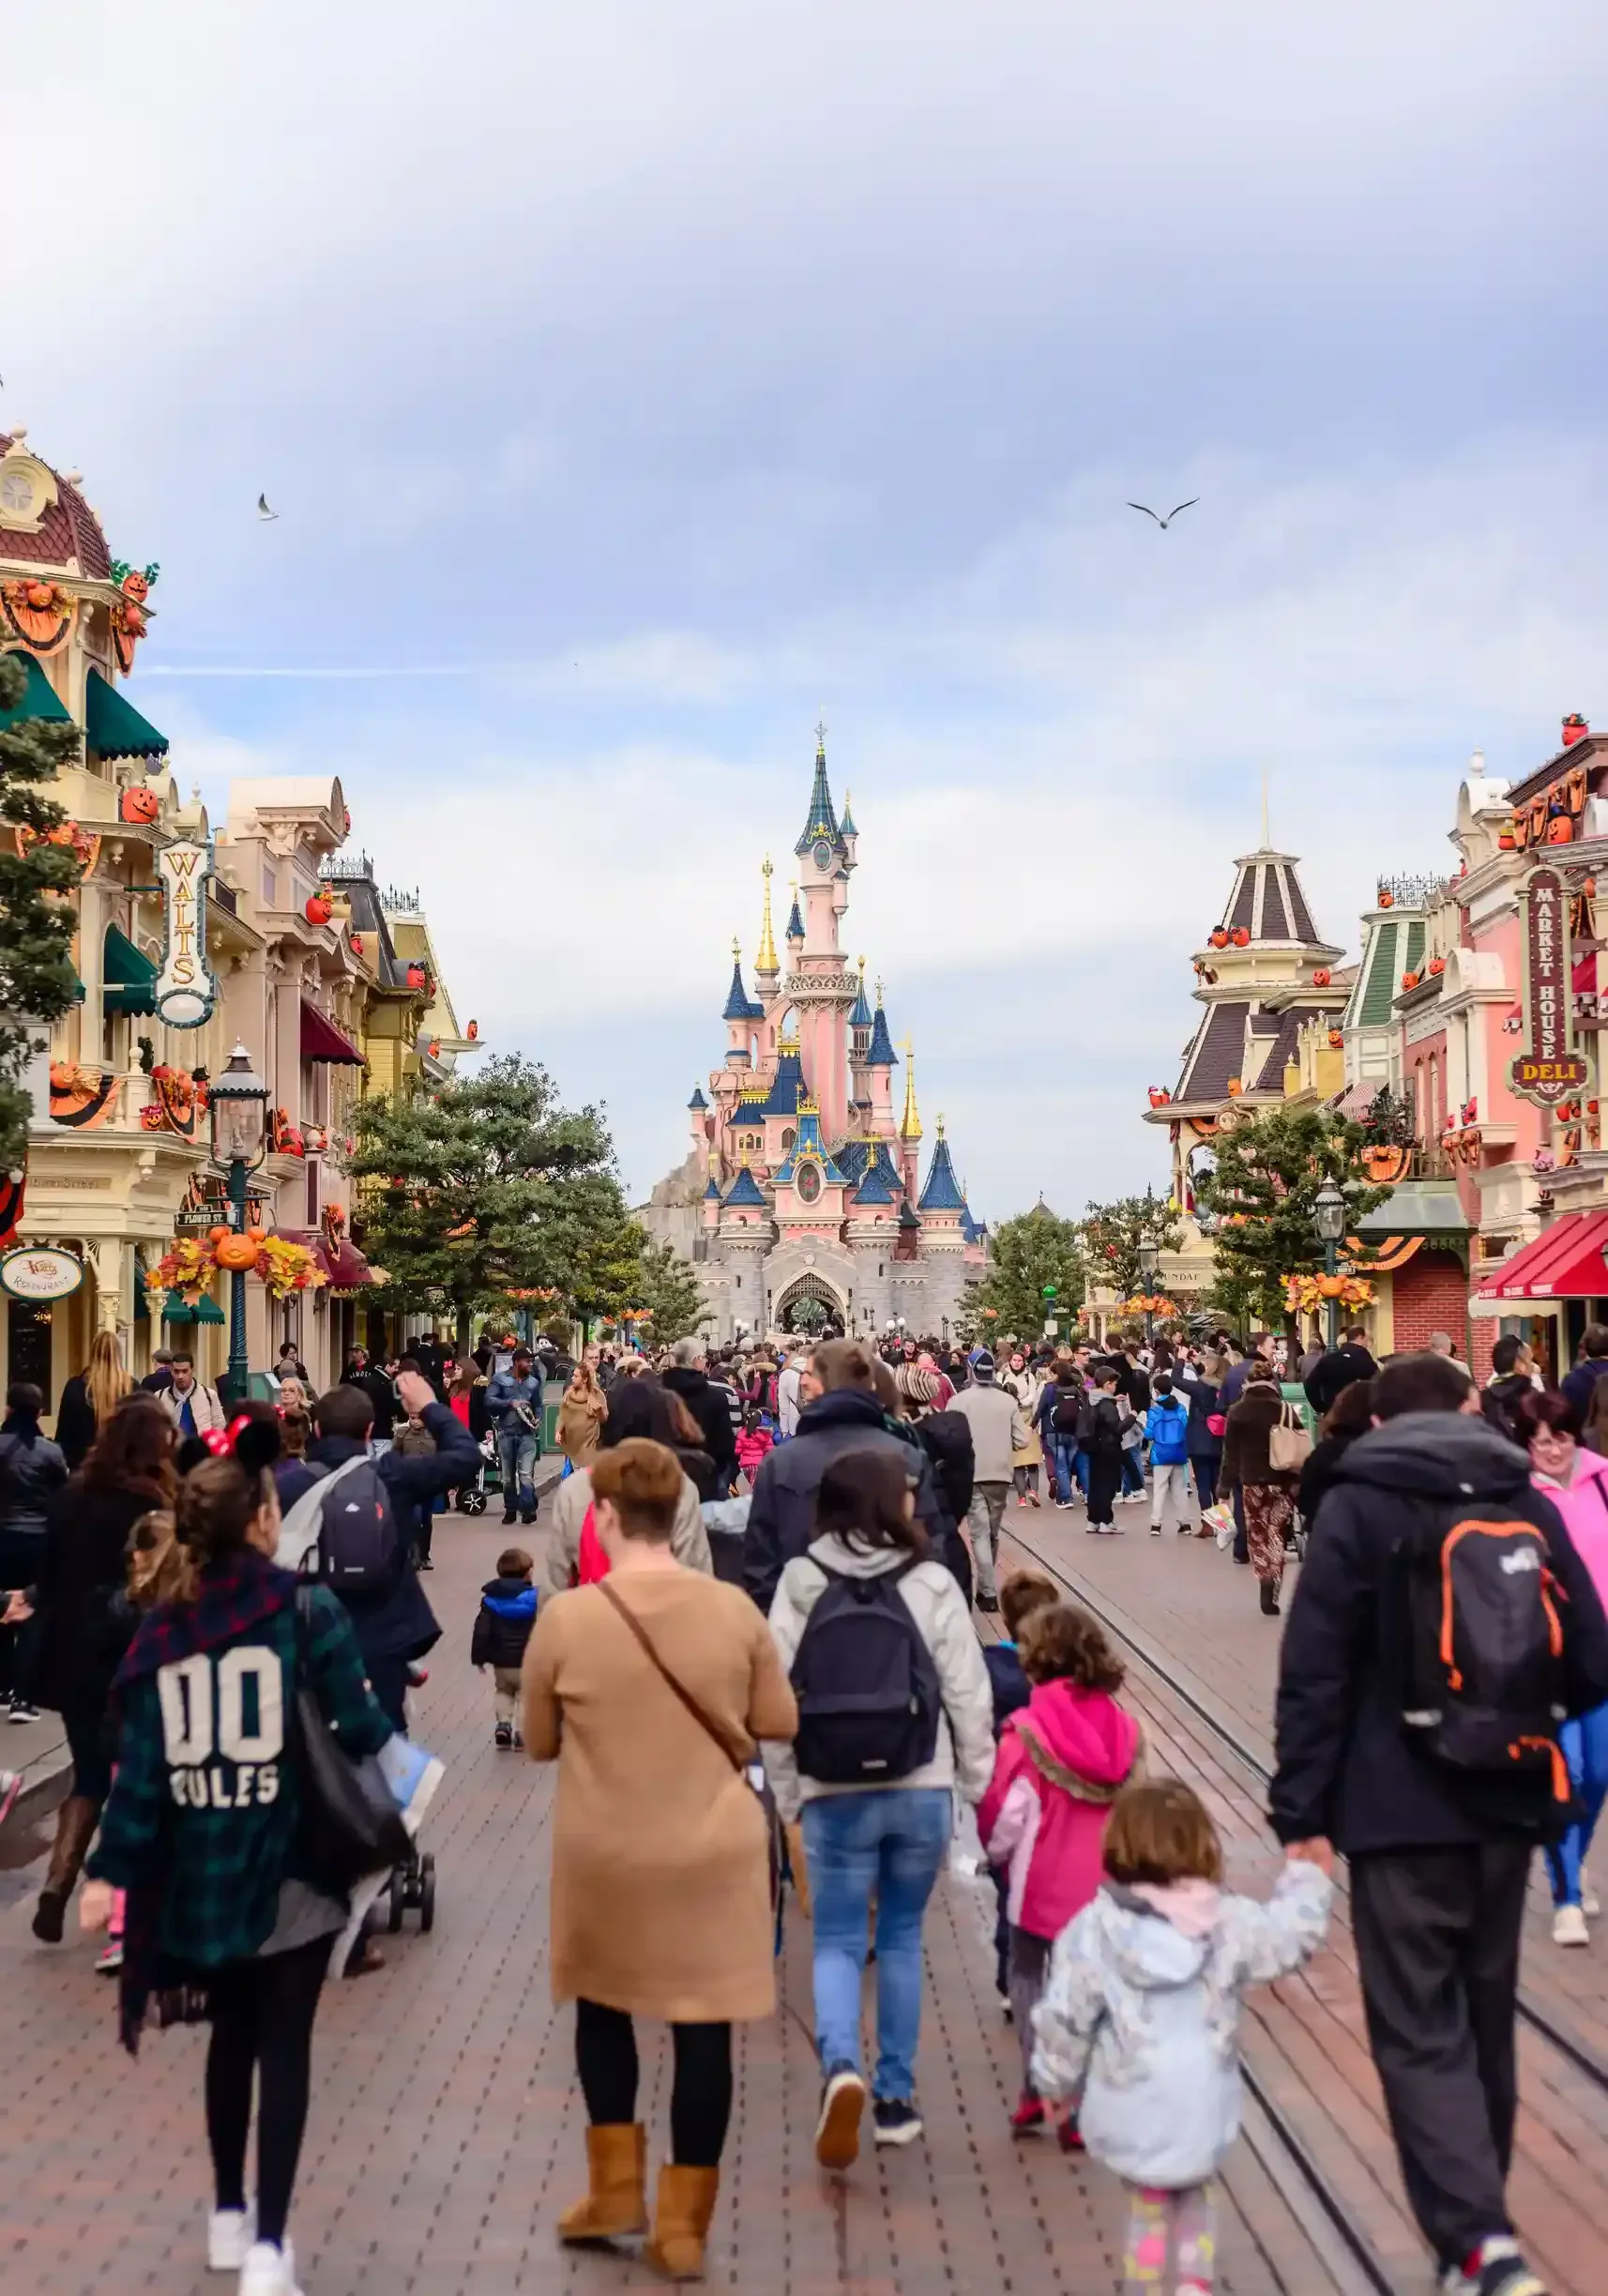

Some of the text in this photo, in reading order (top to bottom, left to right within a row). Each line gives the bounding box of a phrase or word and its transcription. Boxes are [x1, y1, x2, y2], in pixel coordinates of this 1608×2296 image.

[1535, 888, 1556, 1059] MARKET HOUSE
[1523, 1064, 1577, 1080] DELI
[184, 1213, 212, 1224] FLOWER
